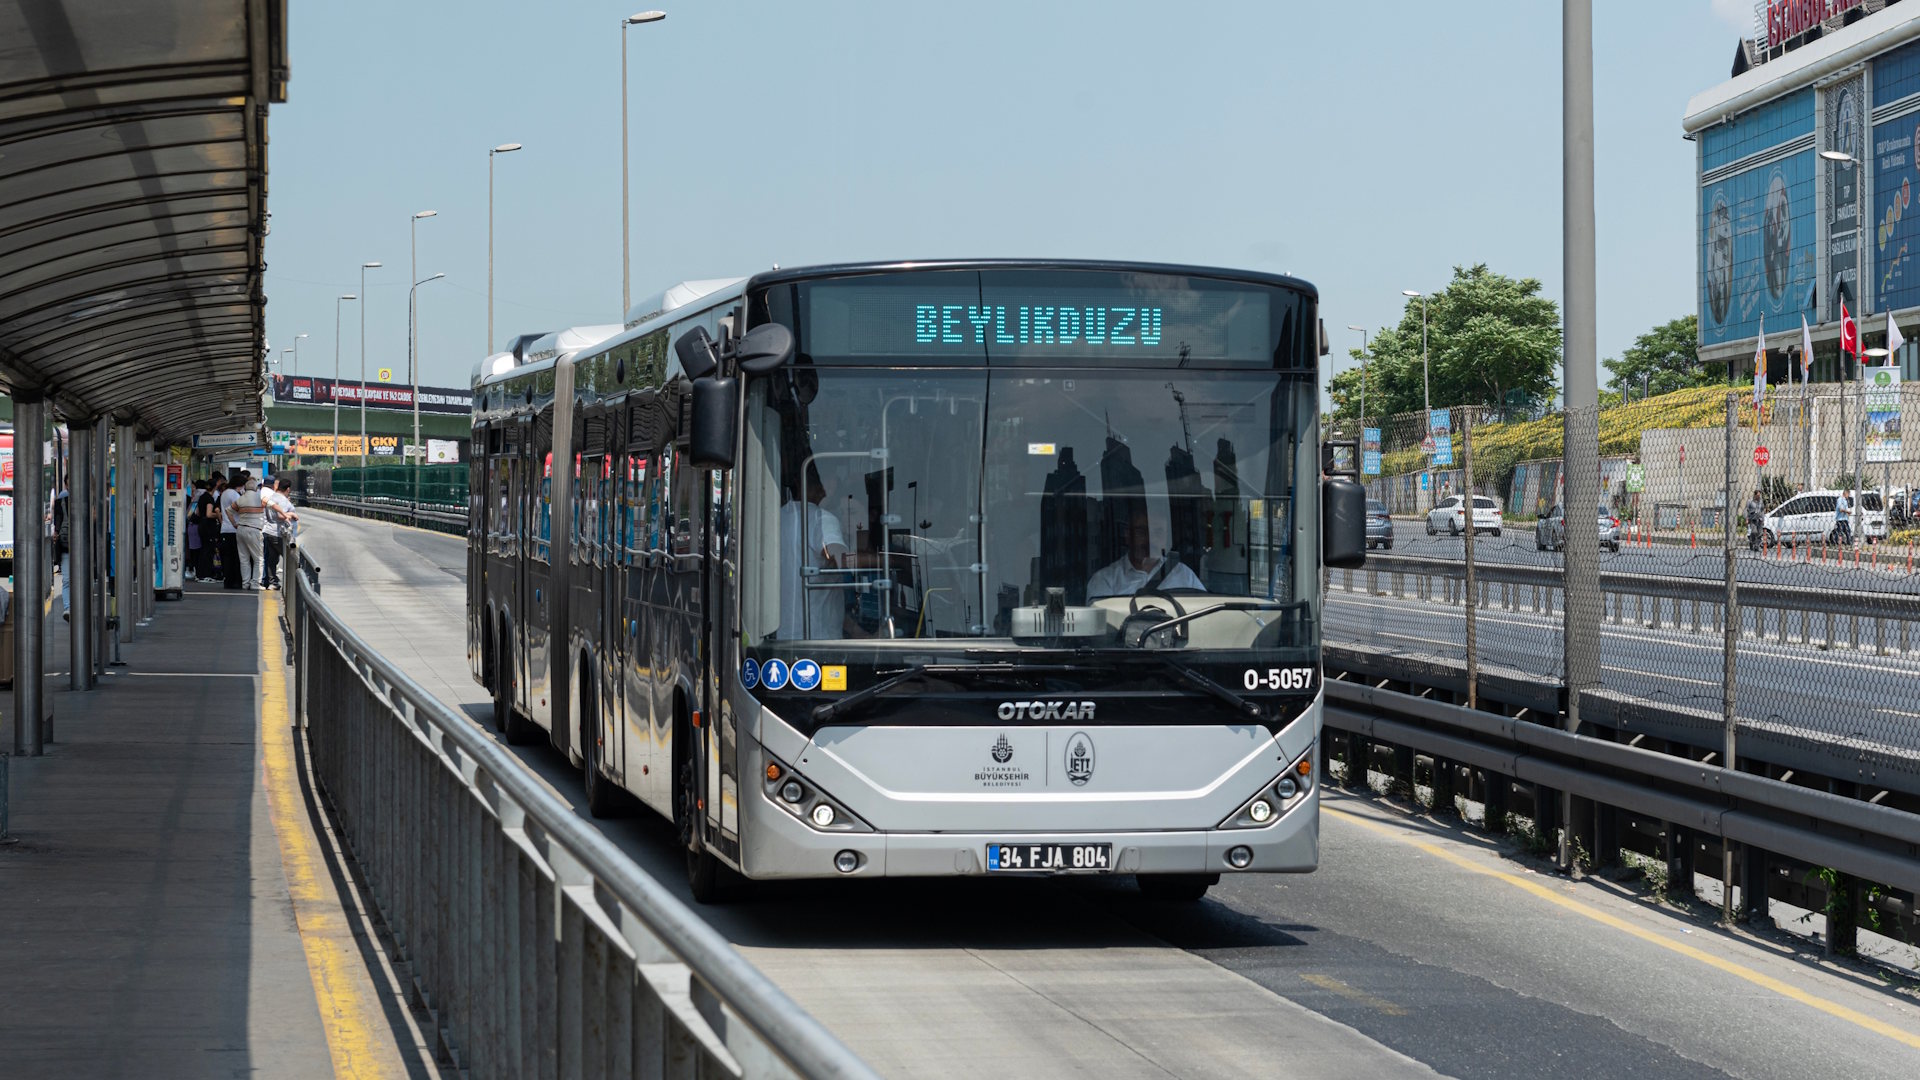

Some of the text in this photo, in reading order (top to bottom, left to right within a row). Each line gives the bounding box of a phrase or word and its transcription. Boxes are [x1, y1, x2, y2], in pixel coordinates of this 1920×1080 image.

[916, 305, 1162, 344] BEYLIKDUZU
[371, 437, 398, 447] GKN
[1754, 452, 1769, 460] DUR
[1243, 668, 1312, 690] O-5057
[997, 701, 1096, 720] OTOKAR
[974, 773, 1029, 781] BÜYÜKŞEHİR
[1000, 847, 1022, 867] 34
[1030, 847, 1063, 868] FJA
[1073, 847, 1107, 867] 804
